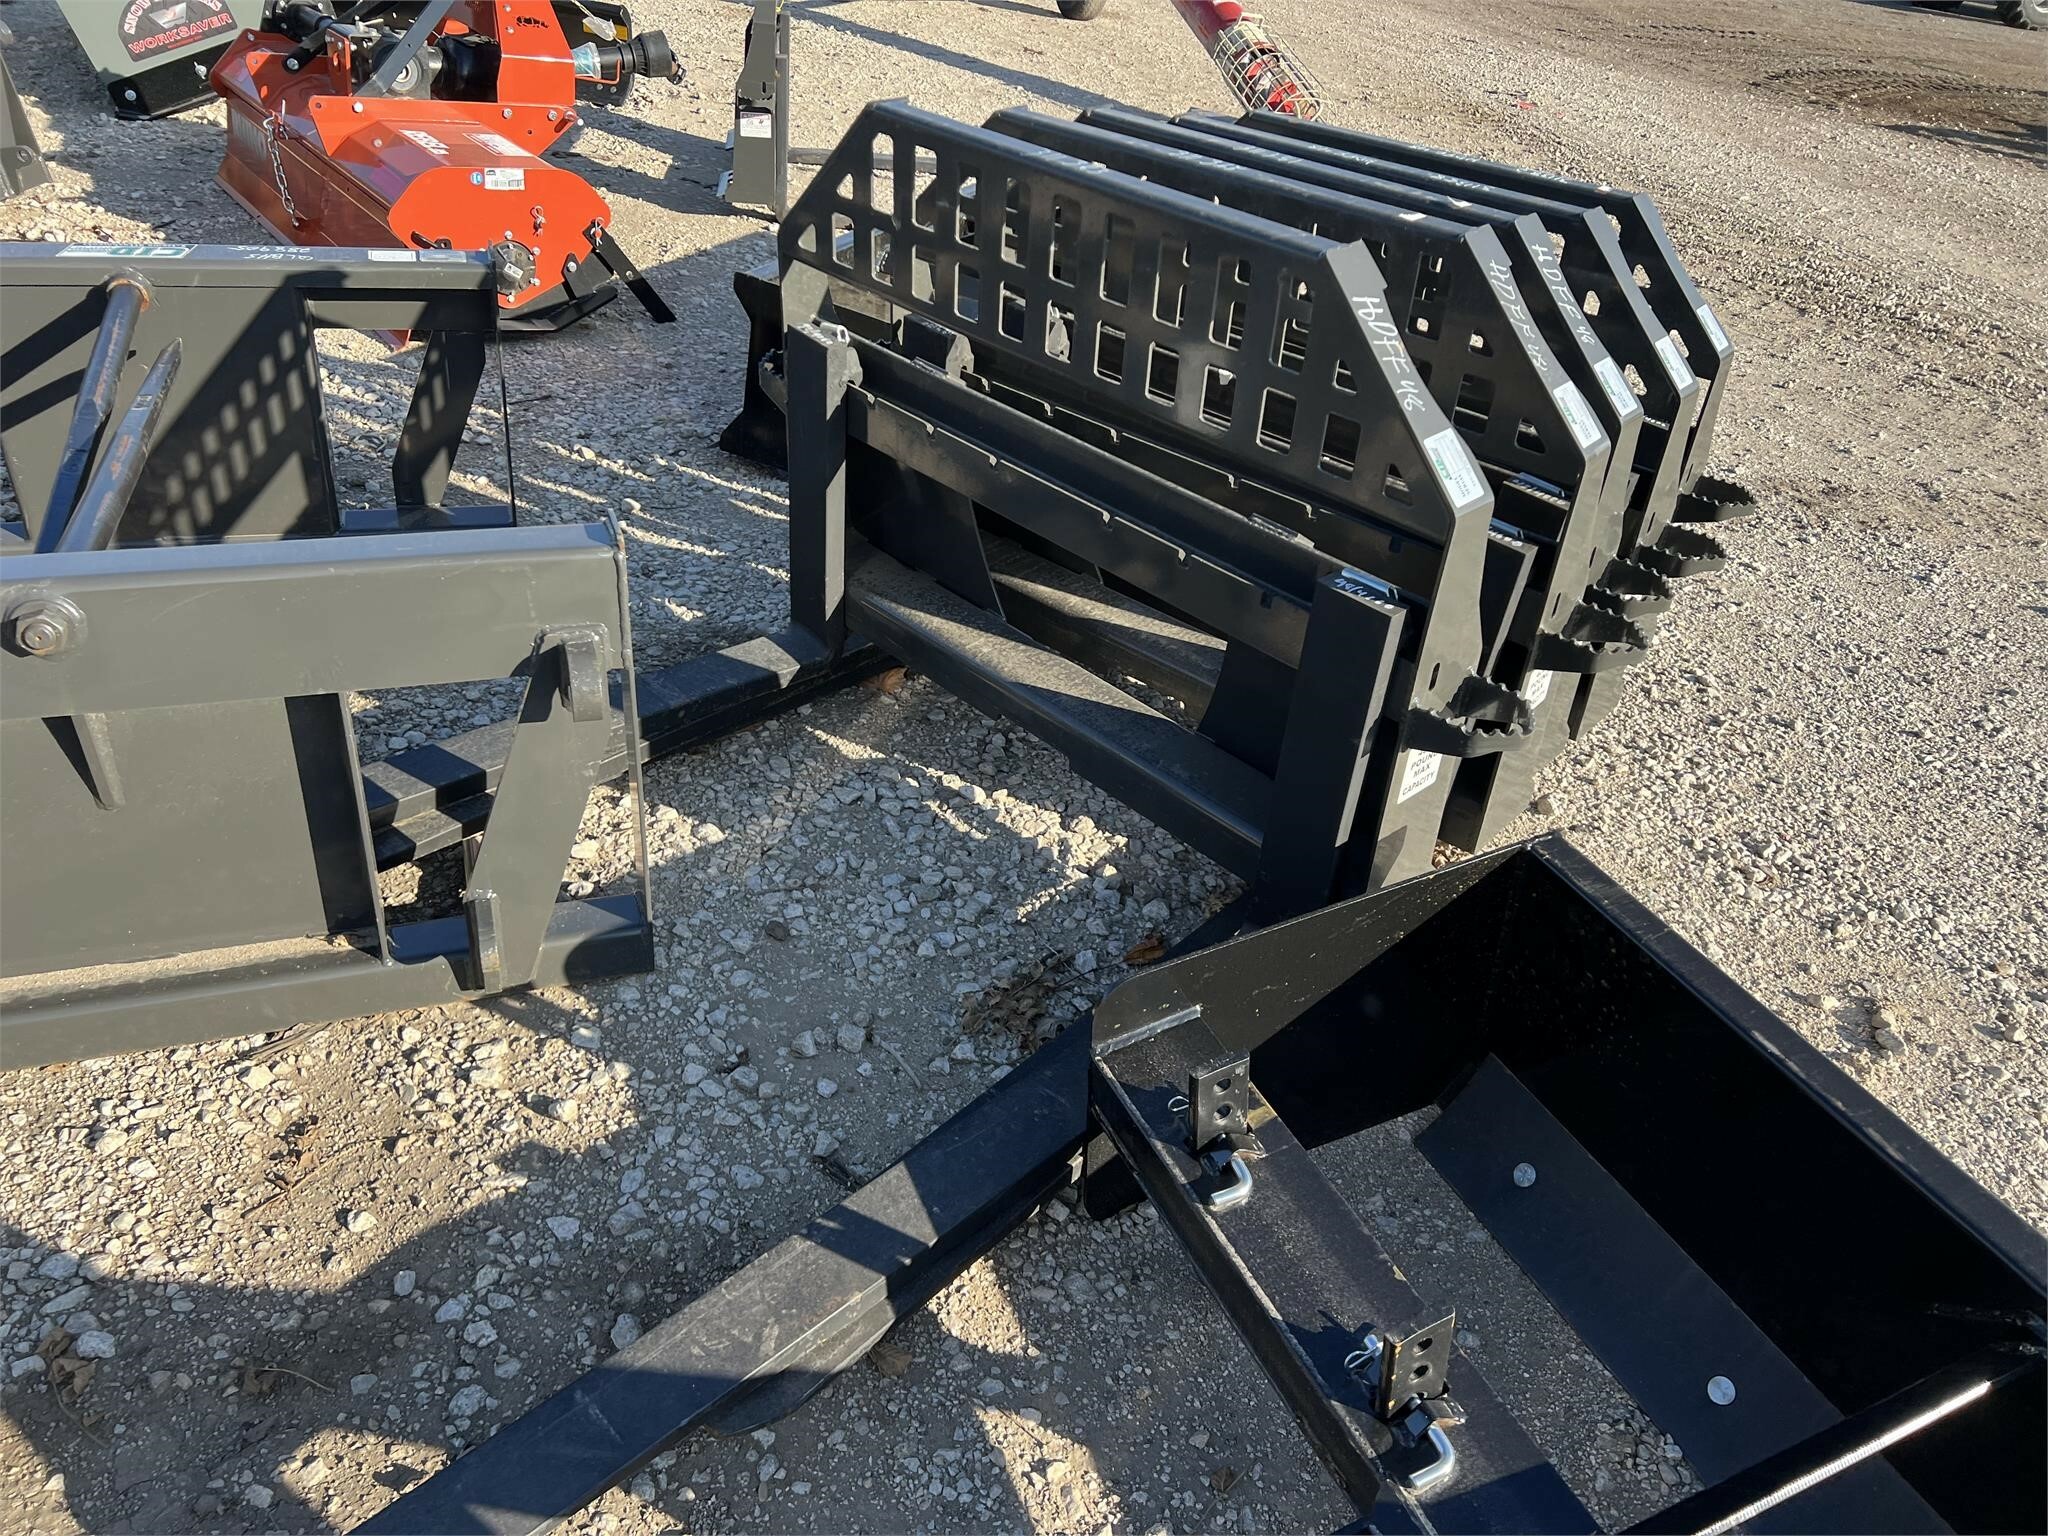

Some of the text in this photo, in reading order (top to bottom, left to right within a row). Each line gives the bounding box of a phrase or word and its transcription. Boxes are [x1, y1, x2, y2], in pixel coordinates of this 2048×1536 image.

[128, 12, 232, 54] WORKSAVER
[1414, 763, 1431, 777] MAX
[1402, 771, 1435, 796] CAPACITY
